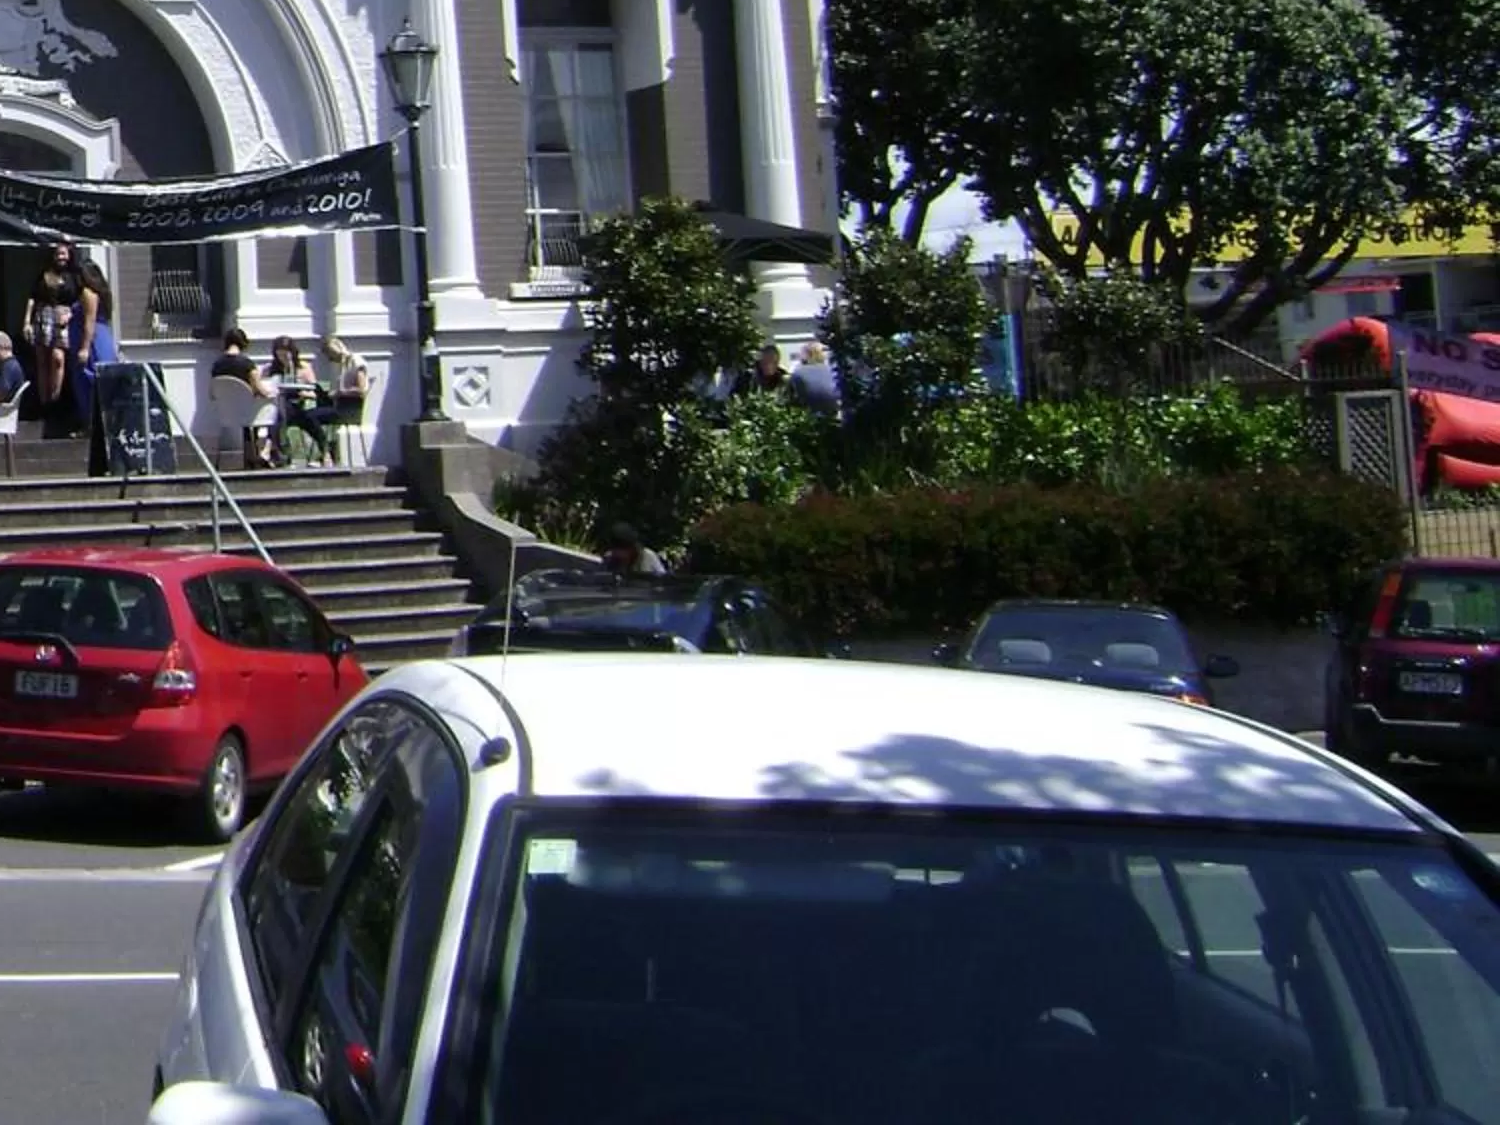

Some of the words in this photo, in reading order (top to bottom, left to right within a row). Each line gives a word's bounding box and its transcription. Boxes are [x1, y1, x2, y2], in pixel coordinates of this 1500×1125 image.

[201, 199, 265, 223] 2009
[306, 187, 373, 213] 2010!
[1412, 330, 1468, 362] NO
